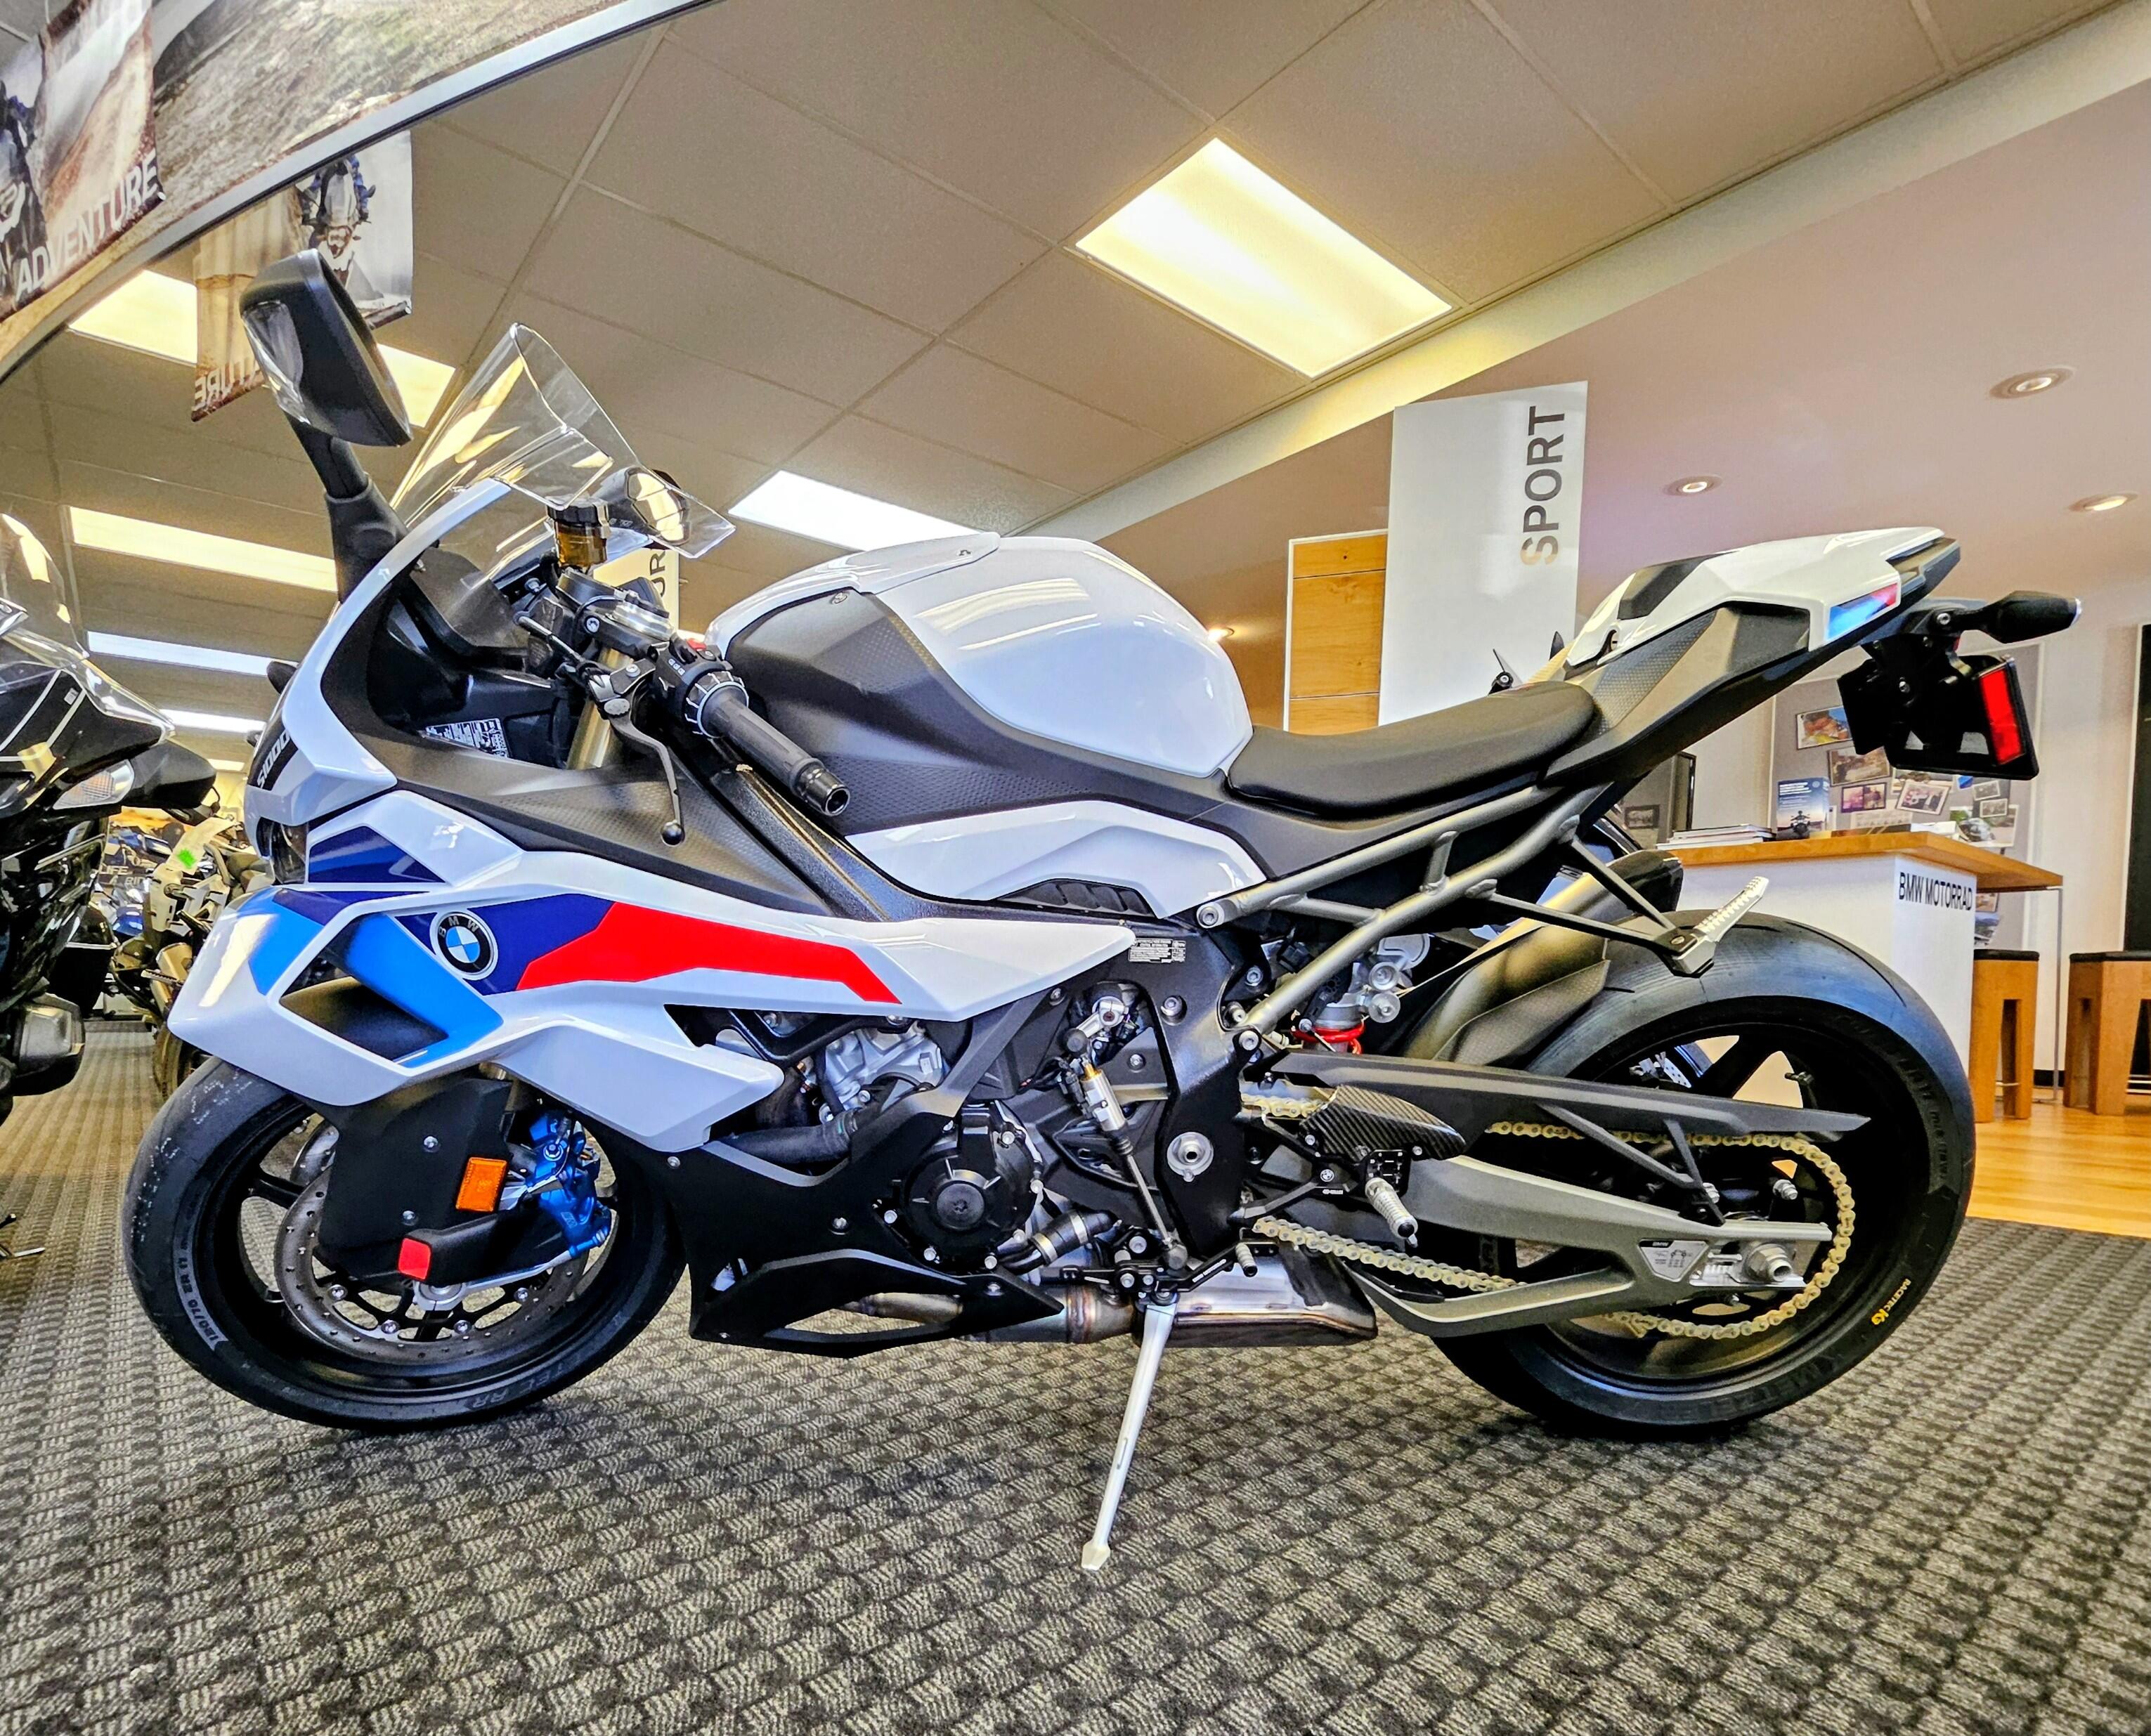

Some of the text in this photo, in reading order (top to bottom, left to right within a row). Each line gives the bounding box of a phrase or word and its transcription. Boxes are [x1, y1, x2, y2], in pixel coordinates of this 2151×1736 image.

[15, 148, 157, 301] ADVENTURE
[1520, 405, 1565, 566] SPORT
[1899, 871, 1973, 911] BMW MOTORRAD
[438, 915, 479, 939] BMW
[1883, 1278, 1912, 1312] RACETEC
